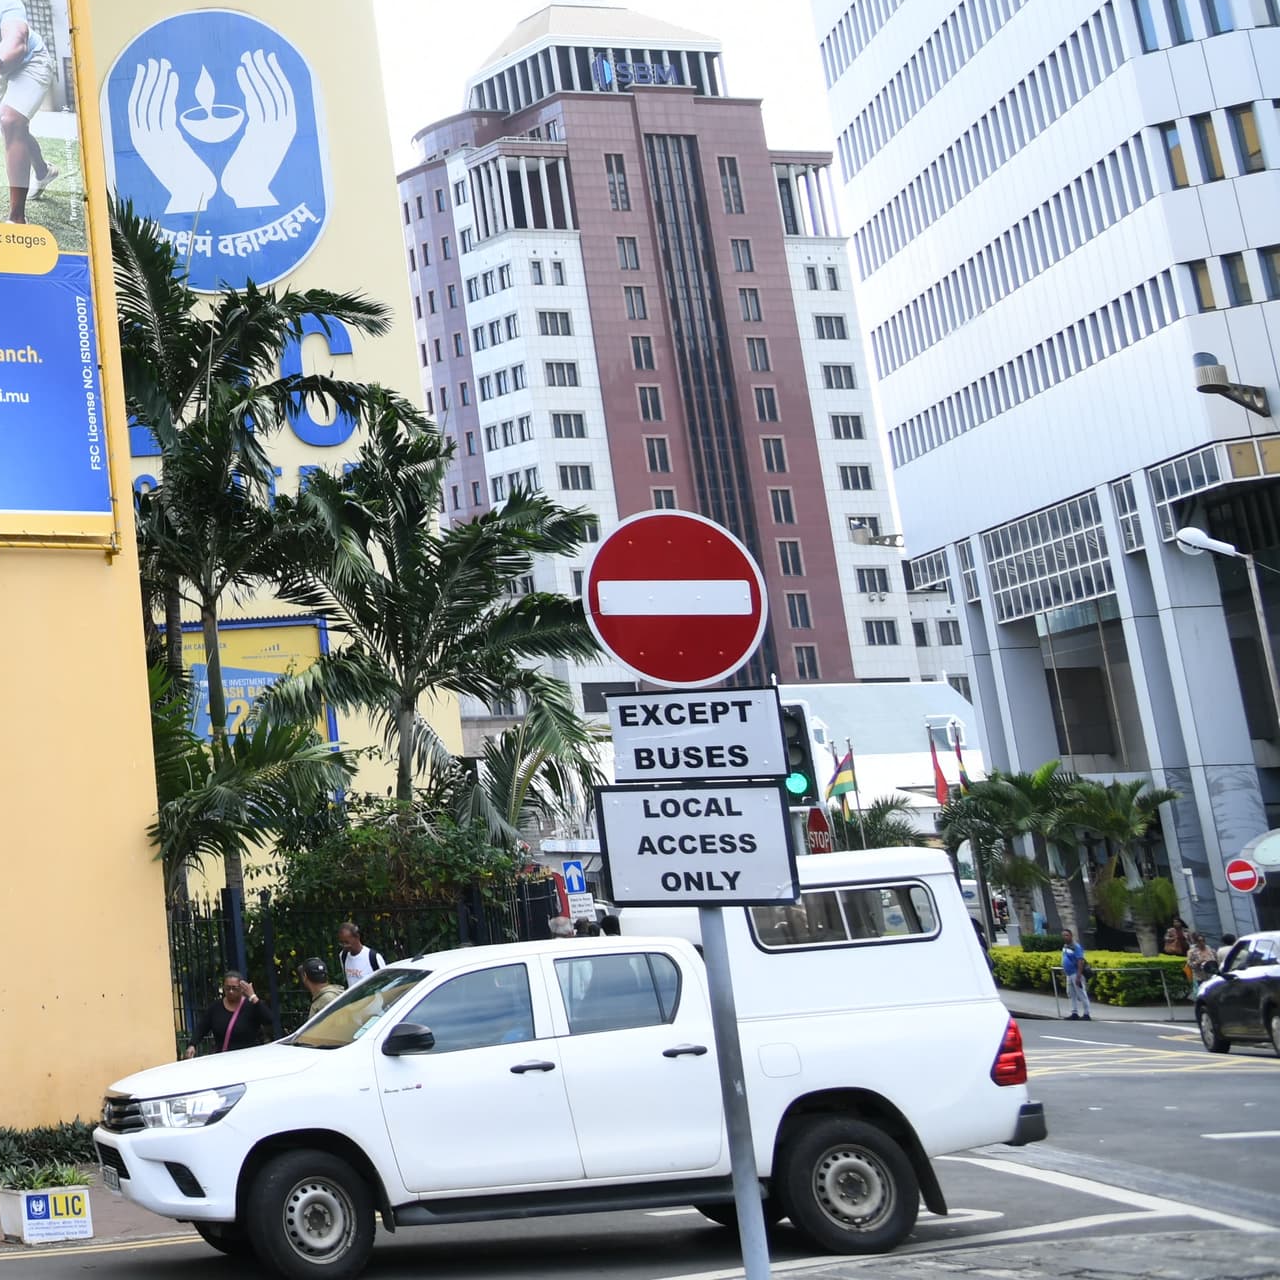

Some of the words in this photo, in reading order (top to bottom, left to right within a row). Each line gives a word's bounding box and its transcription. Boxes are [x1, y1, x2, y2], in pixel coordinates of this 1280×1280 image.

[616, 62, 679, 84] SBM
[5, 234, 47, 248] stages
[76, 296, 91, 363] IS10000017
[83, 365, 93, 389] NO:
[87, 392, 99, 442] License
[90, 445, 101, 470] FSC
[223, 686, 244, 698] ASH
[618, 700, 752, 727] EXCEPT
[634, 744, 749, 770] BUSES
[643, 797, 743, 818] LOCAL
[638, 833, 757, 856] ACCESS
[809, 831, 830, 849] STOP
[661, 871, 741, 892] ONLY
[53, 1195, 82, 1216] LIC
